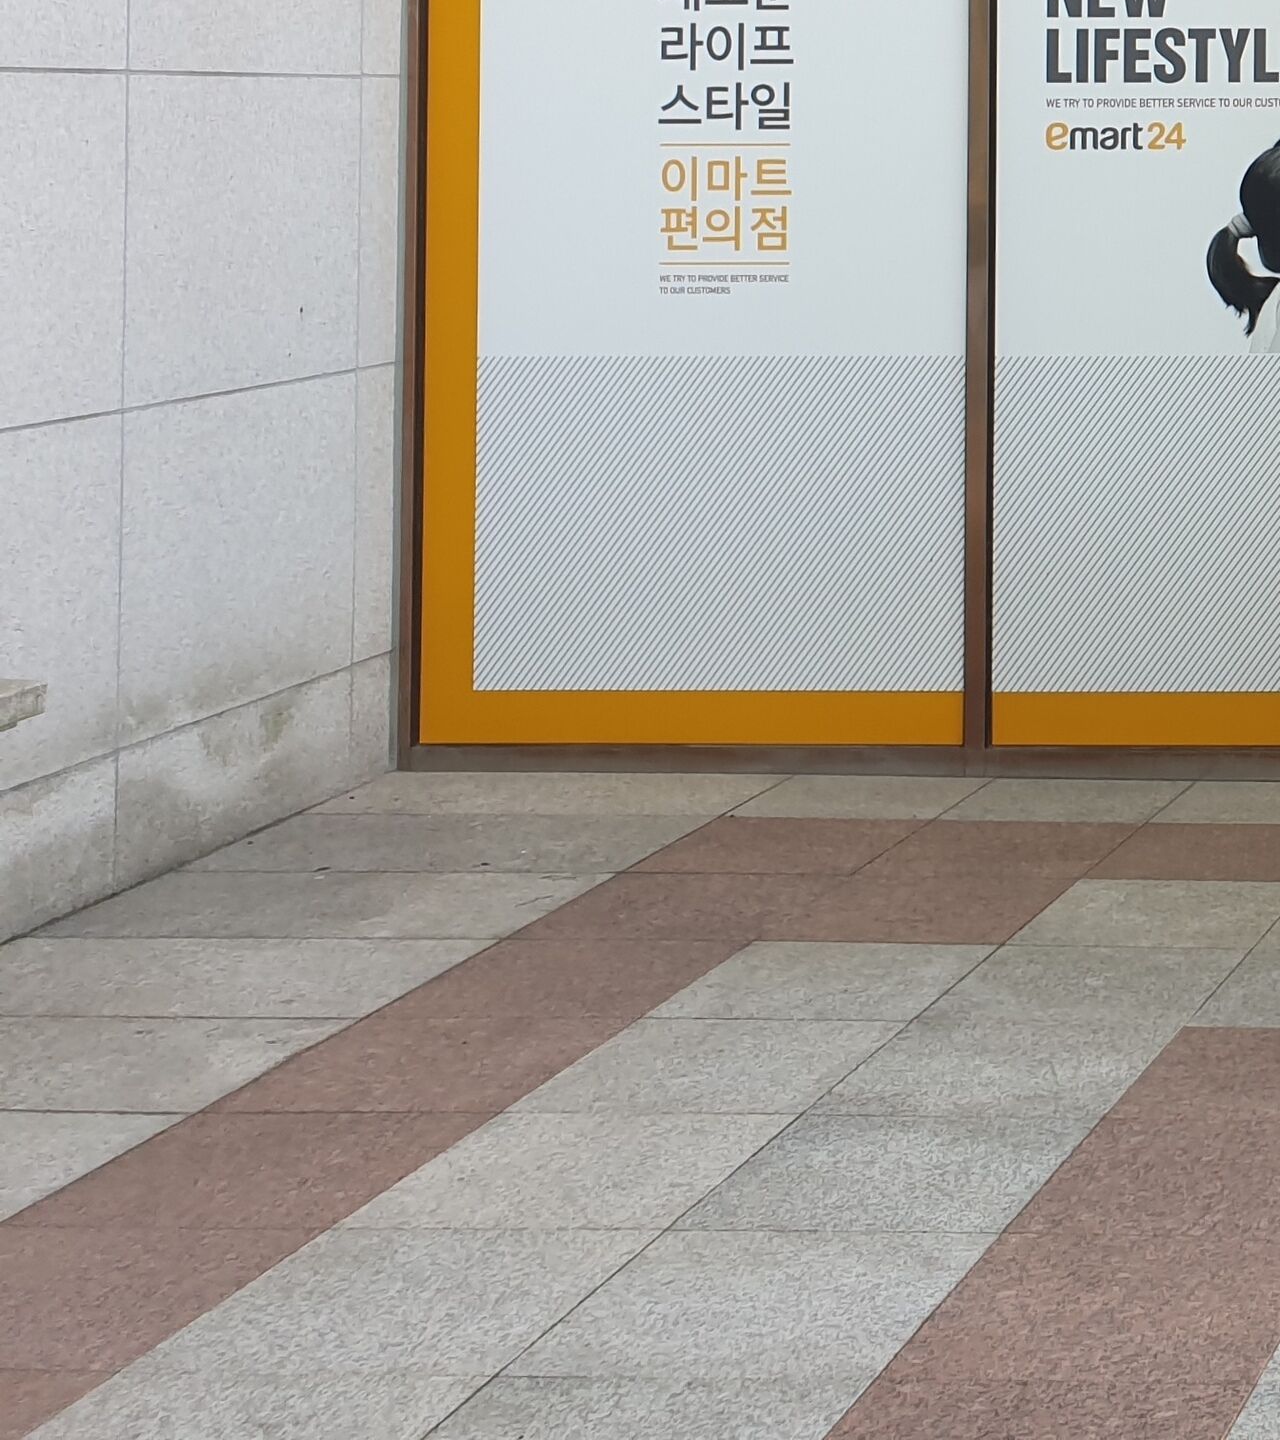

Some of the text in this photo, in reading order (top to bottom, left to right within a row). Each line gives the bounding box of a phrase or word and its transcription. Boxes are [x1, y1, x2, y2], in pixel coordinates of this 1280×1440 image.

[660, 22, 794, 71] 라이프
[658, 81, 791, 130] 스타일
[1046, 98, 1061, 108] WE
[1063, 98, 1080, 108] TRY
[1082, 98, 1094, 108] TO
[1097, 98, 1137, 108] PROVIDE
[1139, 97, 1175, 108] BETTER
[1177, 97, 1216, 108] SERVICE
[1219, 97, 1231, 108] TO
[1232, 97, 1252, 107] OUR
[1046, 122, 1187, 150] emart24
[661, 156, 793, 202] 이마트
[660, 205, 788, 252] 편의점
[660, 286, 731, 294] TO OUR CUSTOMERS
[759, 274, 789, 282] SERVICE
